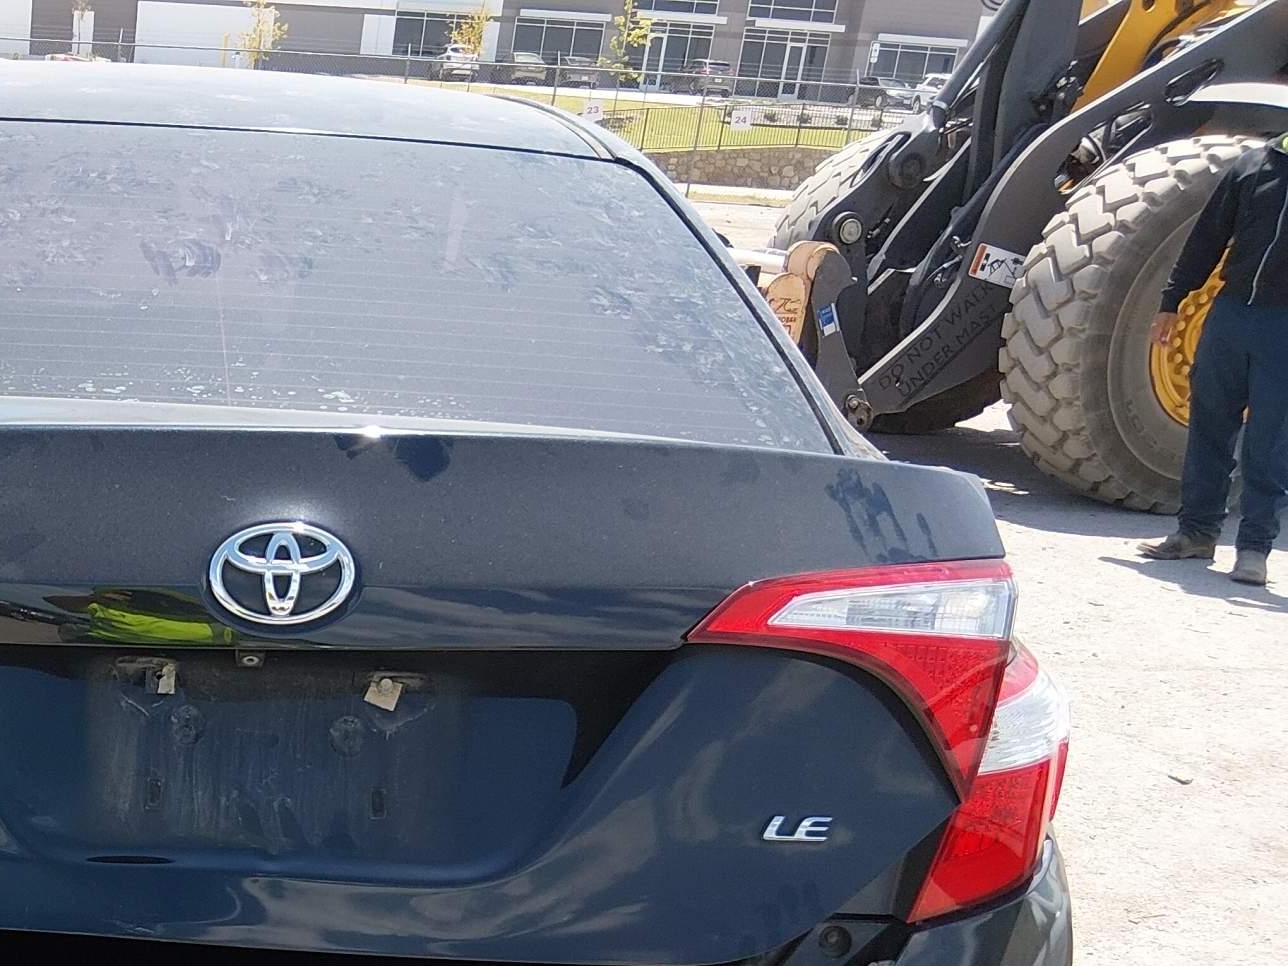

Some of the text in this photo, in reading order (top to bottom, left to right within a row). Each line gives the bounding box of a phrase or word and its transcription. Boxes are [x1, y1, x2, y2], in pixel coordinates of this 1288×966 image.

[586, 105, 600, 115] 23
[734, 115, 747, 125] 24
[879, 364, 905, 390] DO
[906, 327, 942, 362] NOT
[898, 304, 997, 397] UNDER MAST
[762, 814, 833, 842] LE
